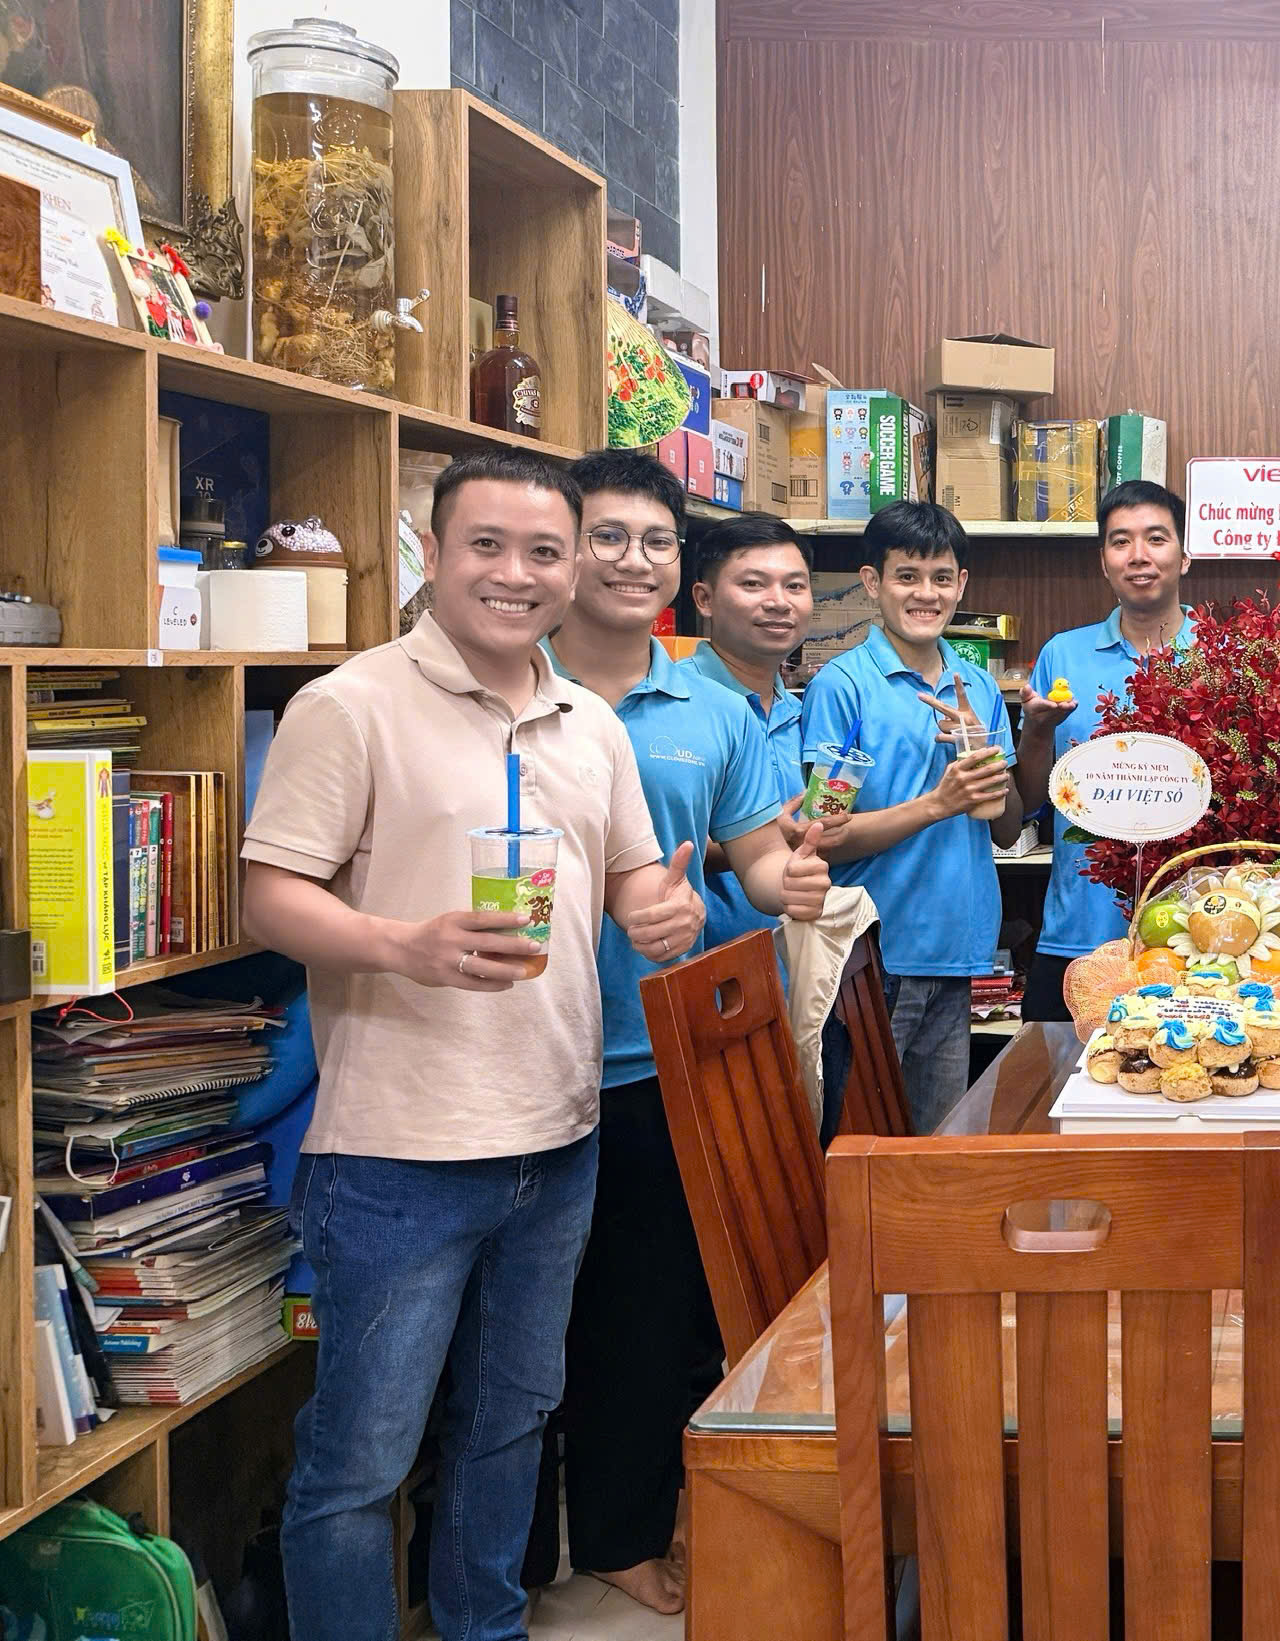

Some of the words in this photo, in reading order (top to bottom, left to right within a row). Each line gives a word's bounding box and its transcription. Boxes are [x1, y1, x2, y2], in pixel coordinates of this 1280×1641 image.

[880, 415, 896, 460] SOCCER
[195, 476, 215, 491] XR
[880, 461, 896, 496] GAME
[1199, 502, 1232, 521] Chúc
[1236, 502, 1275, 526] mừng
[1213, 529, 1253, 551] Công
[1257, 533, 1272, 551] ty
[1112, 761, 1136, 771] MỪNG
[1150, 763, 1169, 773] NIỆM
[1096, 772, 1115, 781] NĂM
[1116, 773, 1142, 783] THÀNH
[1144, 774, 1158, 784] LẬP
[1159, 774, 1179, 784] CÔNG
[1181, 776, 1190, 784] TY
[1093, 788, 1123, 804] ĐẠI
[1127, 788, 1162, 805] VIỆT
[1164, 788, 1183, 804] SỐ
